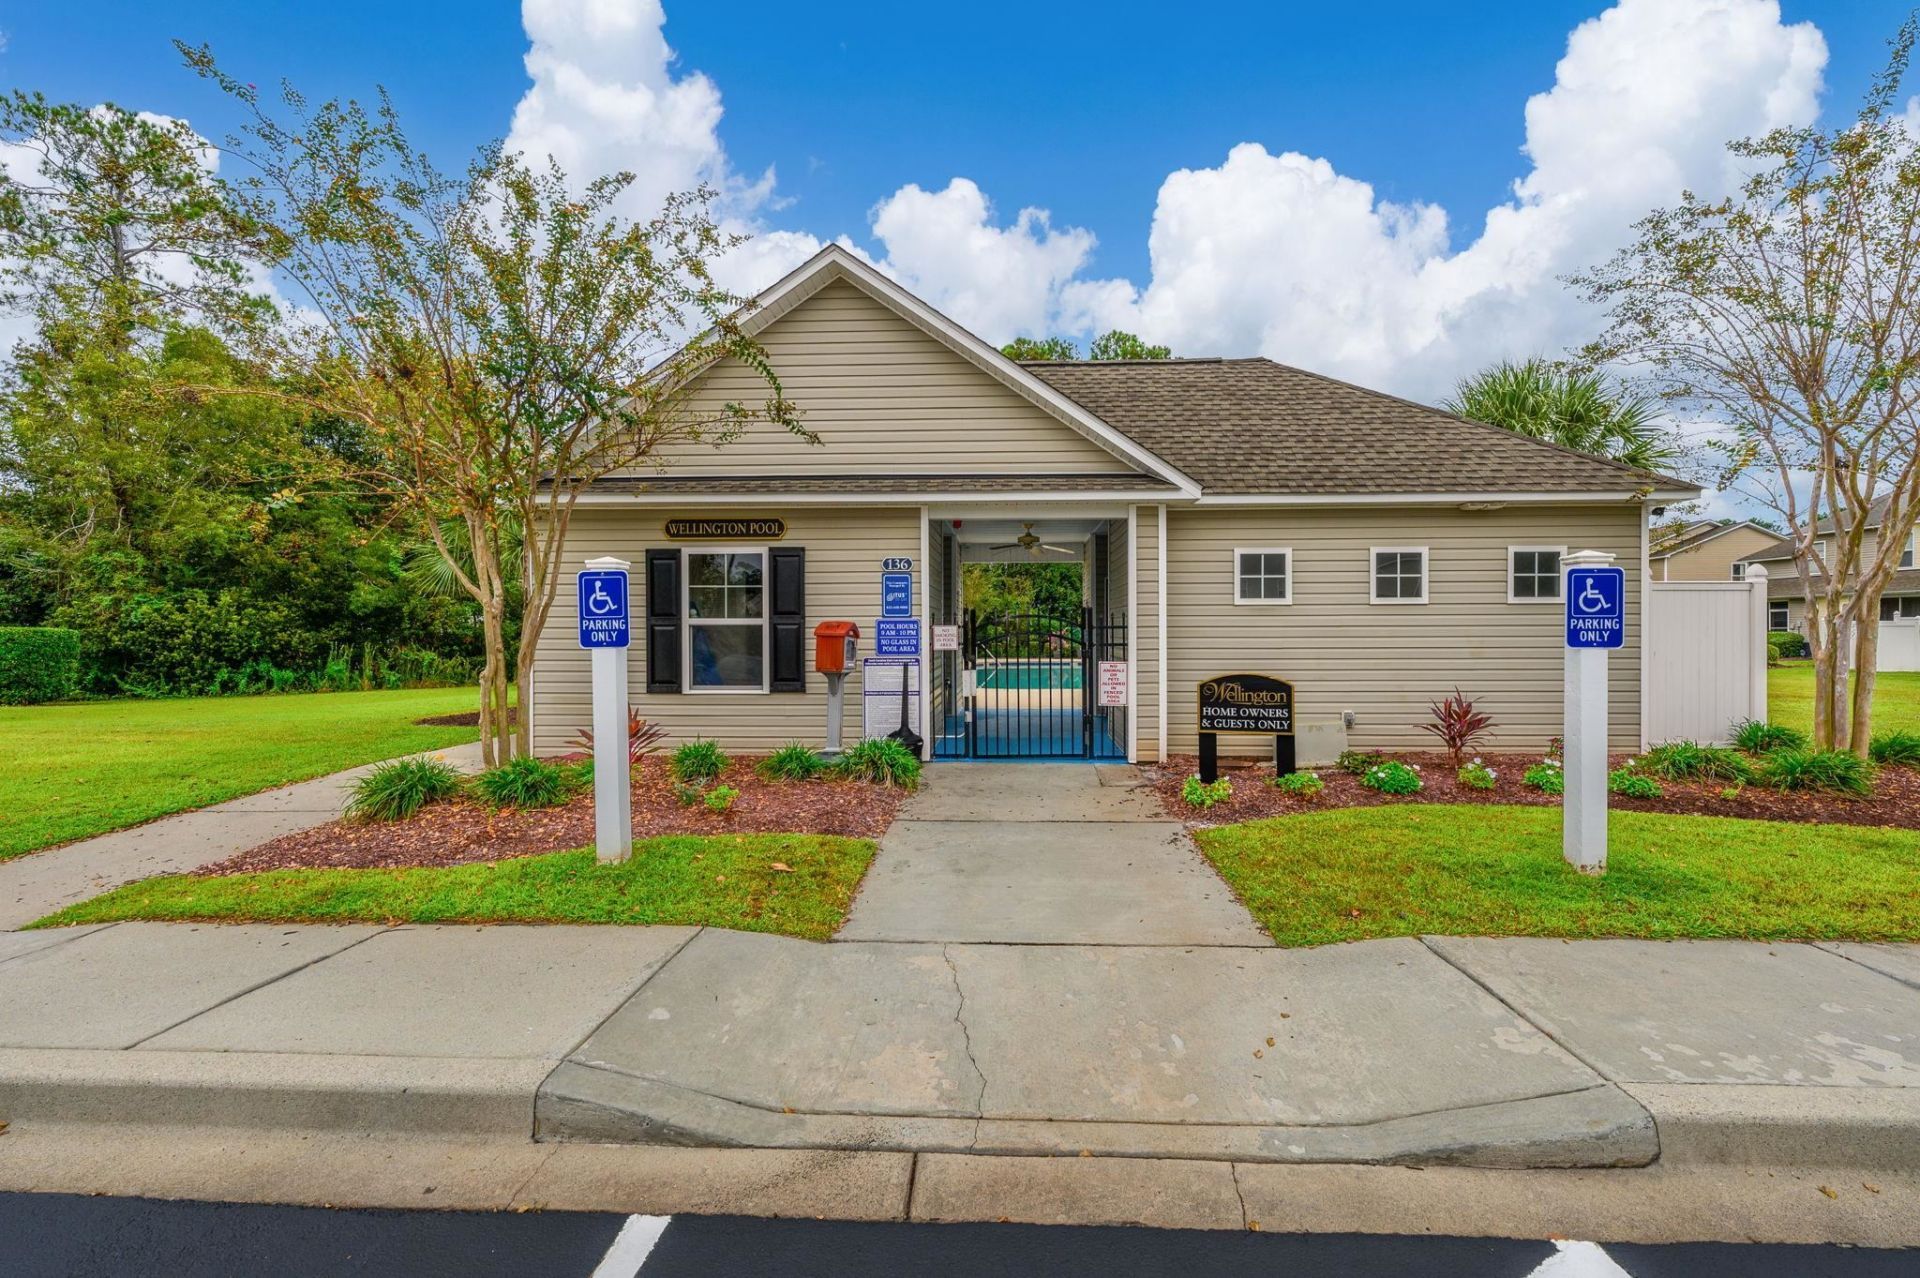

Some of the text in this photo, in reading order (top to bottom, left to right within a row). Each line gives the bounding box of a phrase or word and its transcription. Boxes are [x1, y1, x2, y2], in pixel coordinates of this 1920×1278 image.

[668, 522, 782, 534] WELLINGTON POOL
[887, 559, 908, 570] 136
[582, 619, 626, 630] PARKING
[1570, 618, 1620, 629] PARKING
[591, 631, 618, 642] ONLY
[1580, 630, 1610, 642] ONLY
[1202, 682, 1287, 705] Wellington
[1202, 707, 1289, 718] HOME OWNERS
[1201, 719, 1290, 730] & GUESTS ONLY
